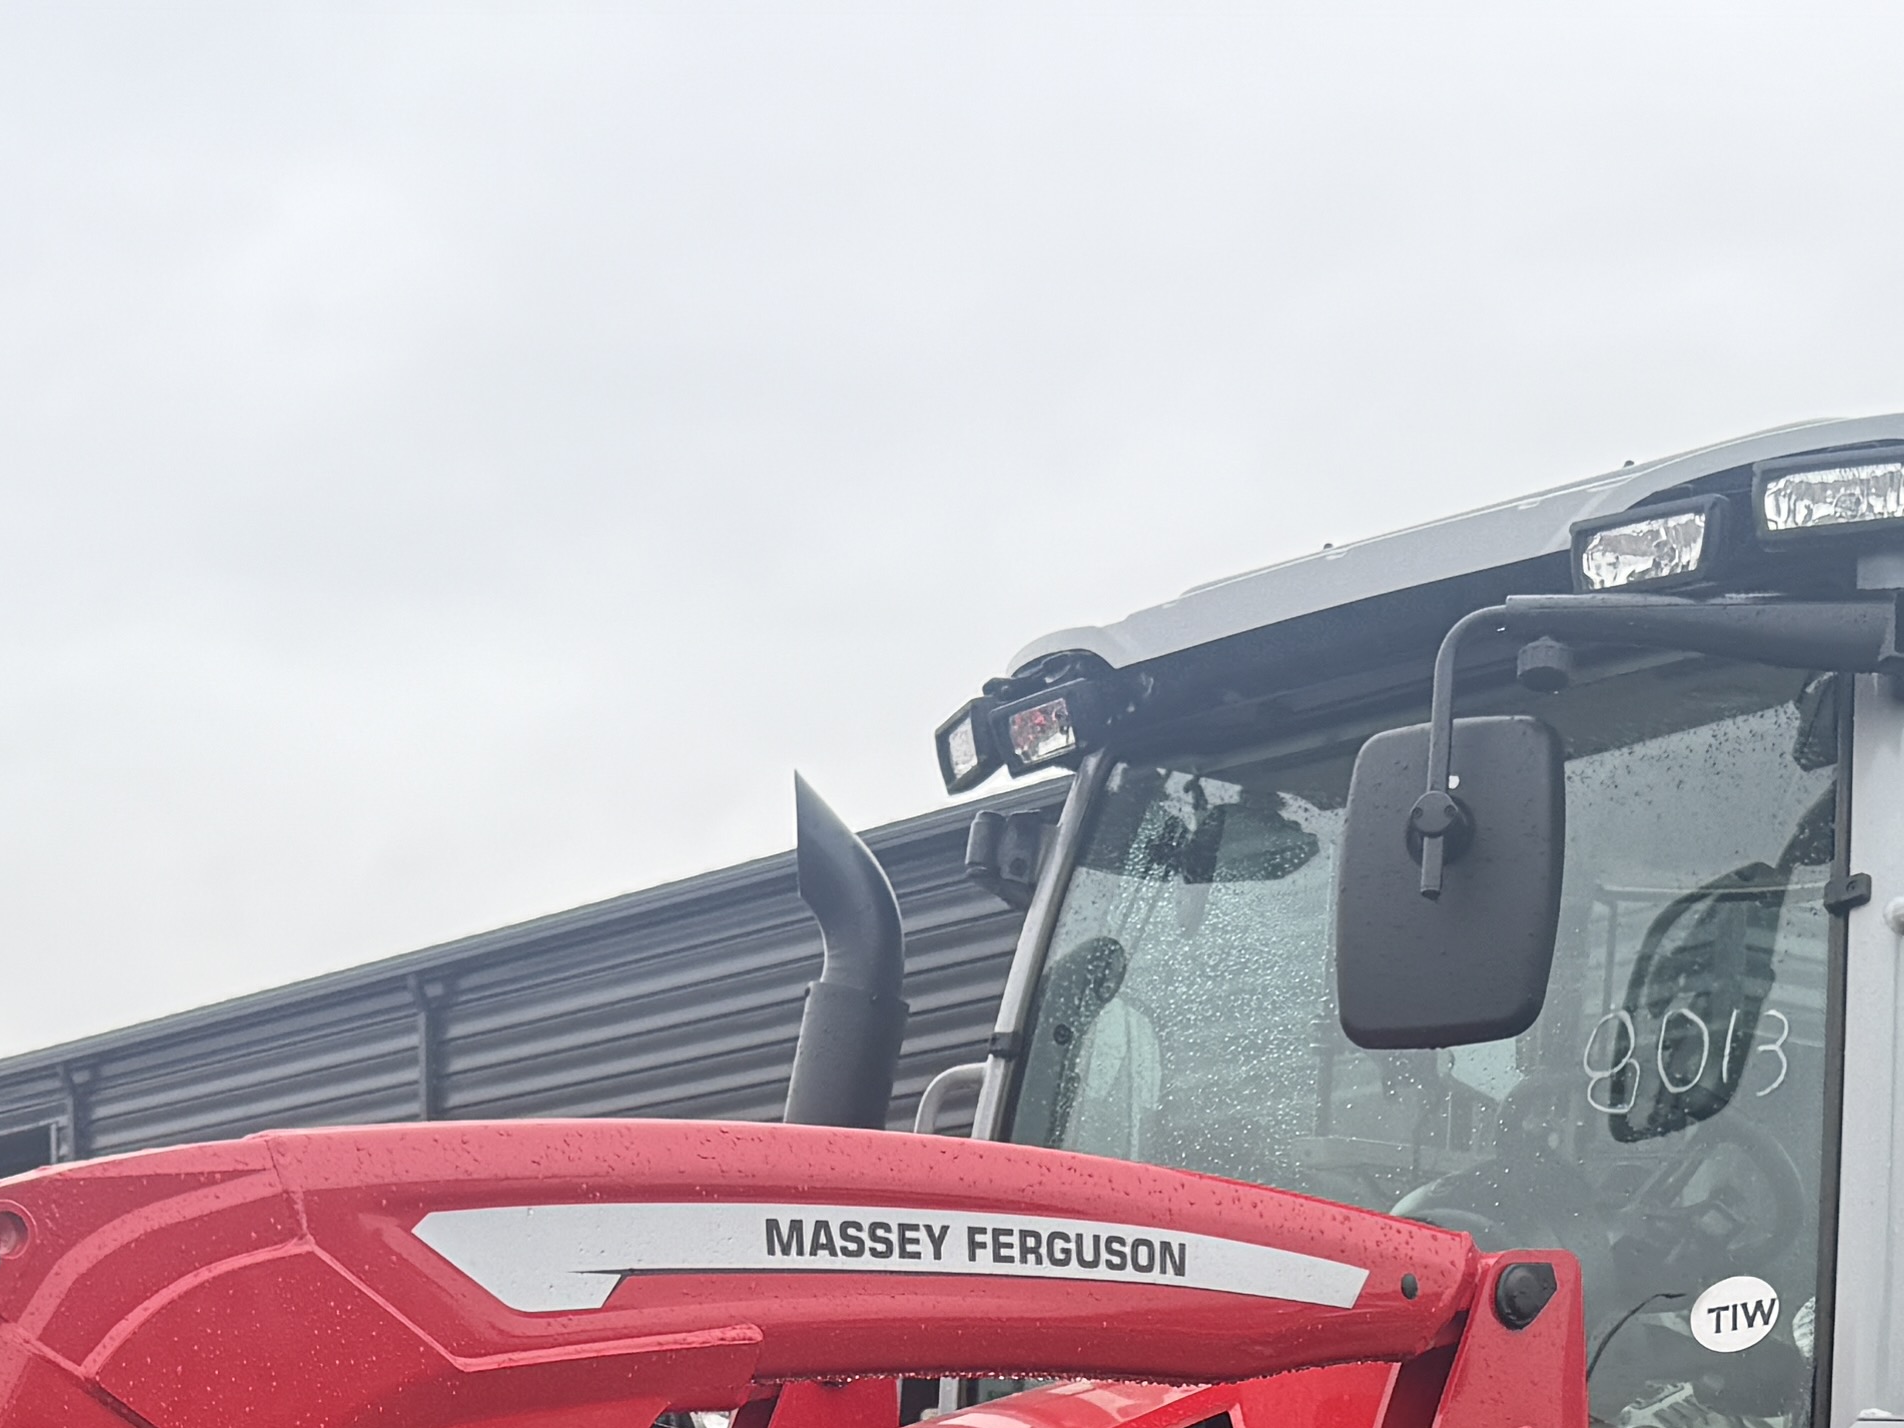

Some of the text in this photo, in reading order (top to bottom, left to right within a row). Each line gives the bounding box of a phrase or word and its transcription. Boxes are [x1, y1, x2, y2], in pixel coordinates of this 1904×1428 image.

[1583, 1007, 1789, 1113] 8013
[764, 1217, 1189, 1279] MASSEY FERGUSON
[1707, 1297, 1777, 1335] TIW
